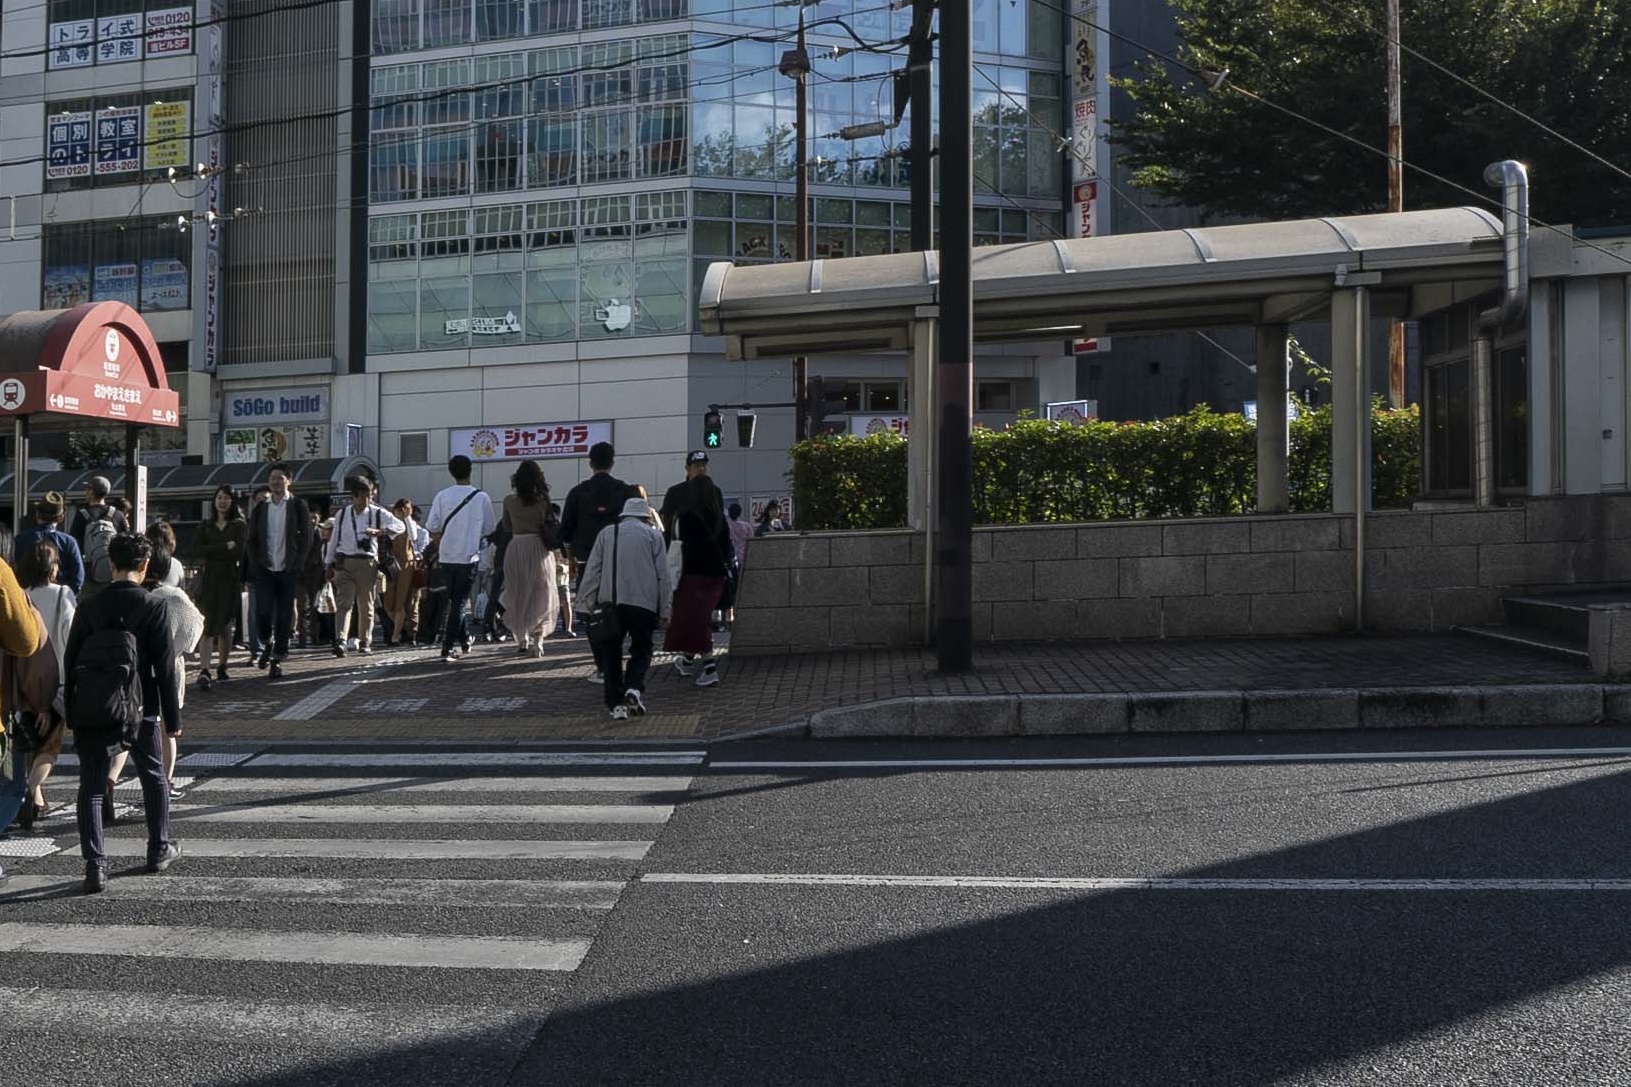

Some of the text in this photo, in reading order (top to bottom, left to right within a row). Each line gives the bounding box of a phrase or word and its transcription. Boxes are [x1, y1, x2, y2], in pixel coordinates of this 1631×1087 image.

[59, 19, 134, 42] トライ式
[56, 40, 134, 63] 高等学院
[52, 119, 137, 143] 個別教室
[280, 394, 320, 413] build
[505, 425, 589, 446] ジャンカラ
